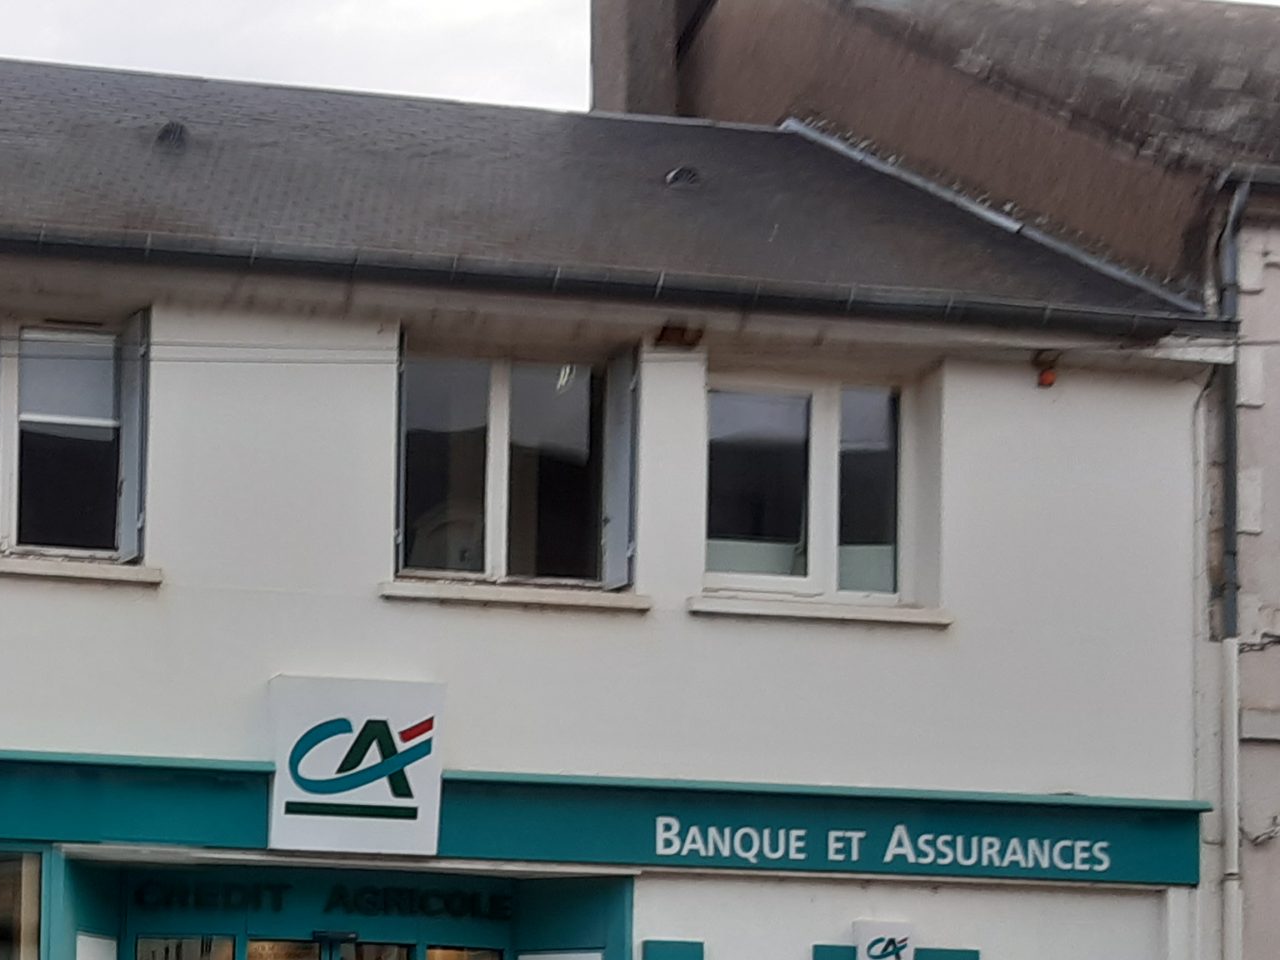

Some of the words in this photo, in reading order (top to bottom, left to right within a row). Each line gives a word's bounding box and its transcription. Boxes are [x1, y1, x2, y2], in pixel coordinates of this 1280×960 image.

[655, 816, 807, 864] BANQUE
[827, 830, 867, 861] ET
[882, 824, 1111, 872] ASSURANCES
